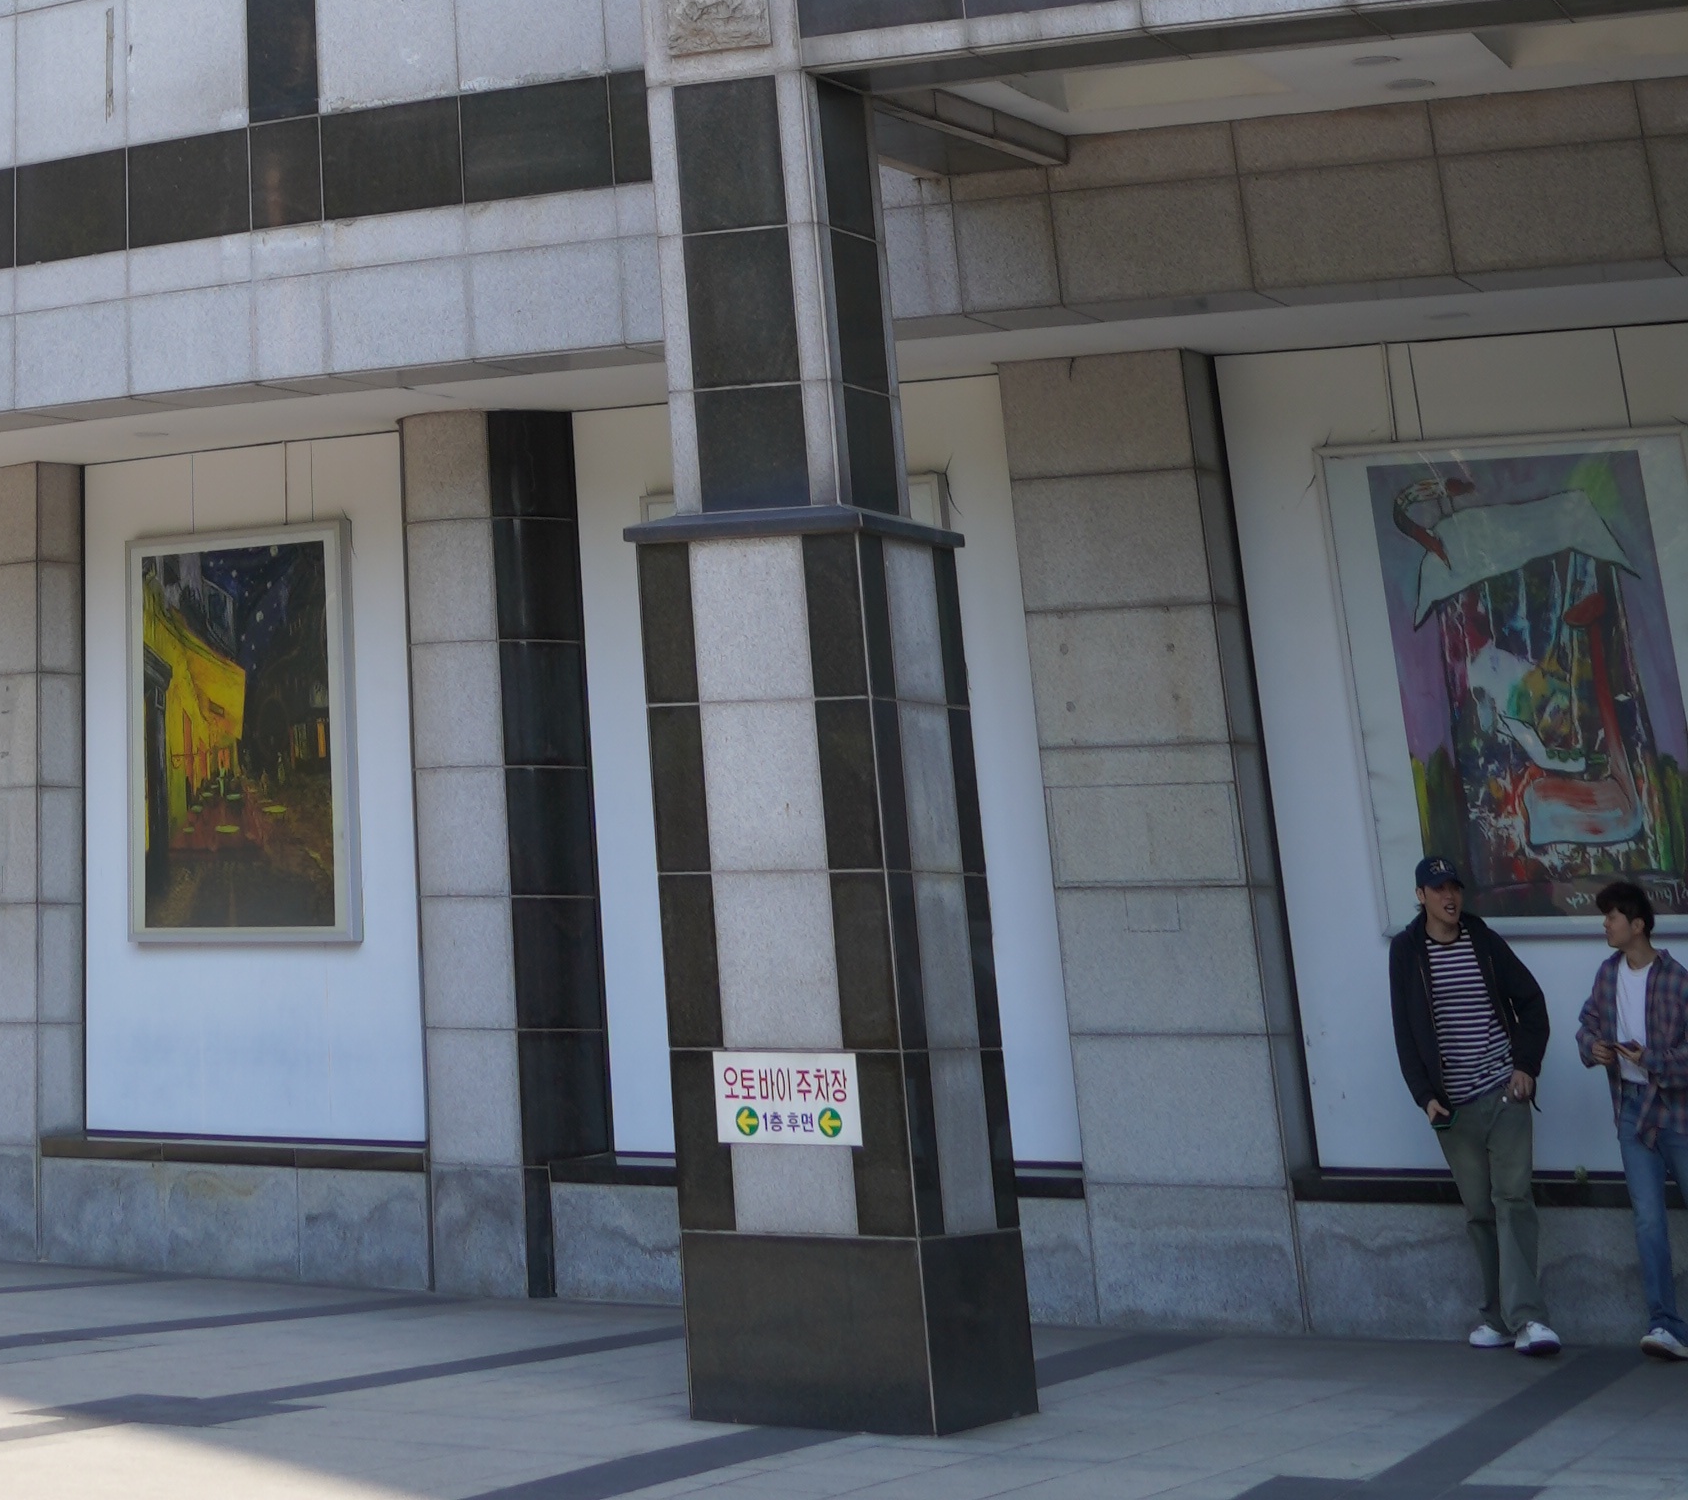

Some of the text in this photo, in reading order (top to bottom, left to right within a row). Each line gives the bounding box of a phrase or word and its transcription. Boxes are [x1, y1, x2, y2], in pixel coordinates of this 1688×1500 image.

[723, 1067, 847, 1103] 오토바이 주차장
[762, 1112, 814, 1133] 1층 후면
